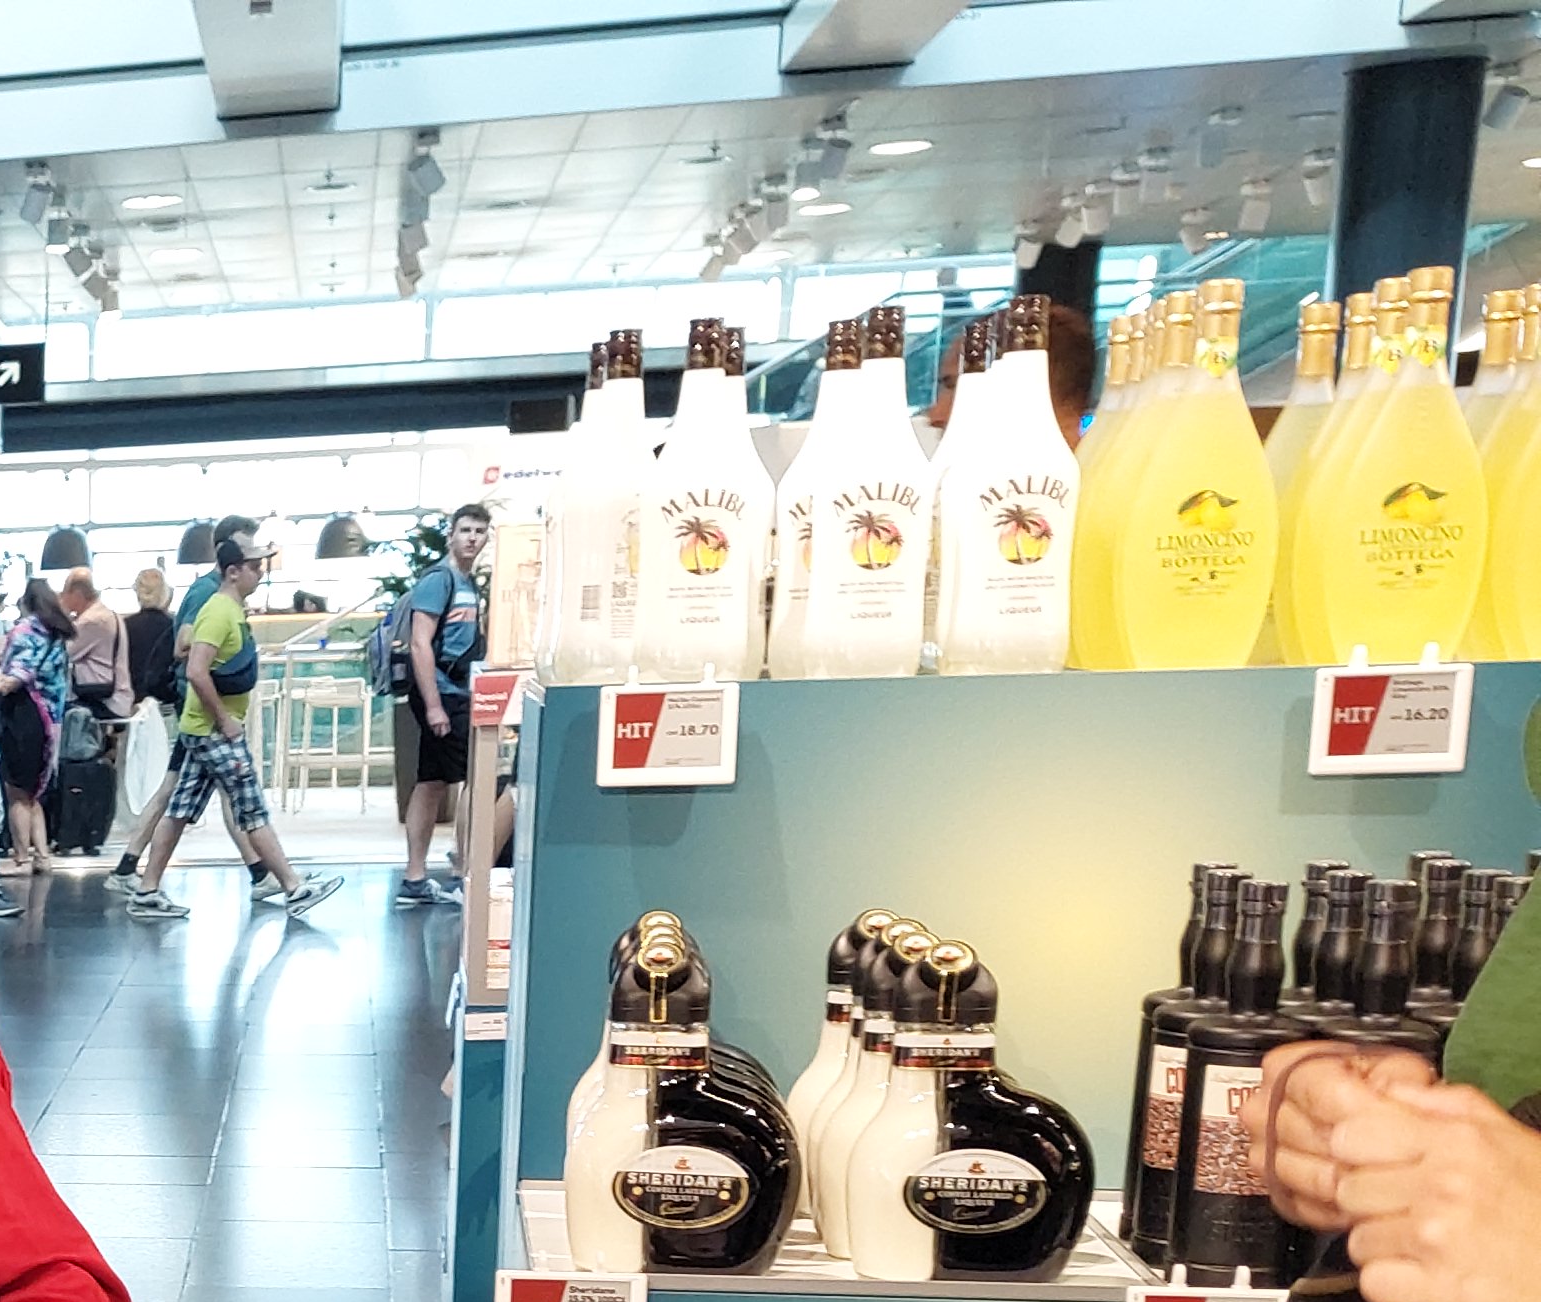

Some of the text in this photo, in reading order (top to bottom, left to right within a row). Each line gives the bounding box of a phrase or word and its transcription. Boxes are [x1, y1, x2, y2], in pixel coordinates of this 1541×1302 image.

[1333, 707, 1375, 725] HIT
[1405, 708, 1448, 721] 16.20
[617, 722, 653, 739] HIT
[679, 724, 719, 737] 18.70
[627, 1172, 733, 1189] SHERIDAN'S
[919, 1177, 1028, 1192] SHERIDAN'S
